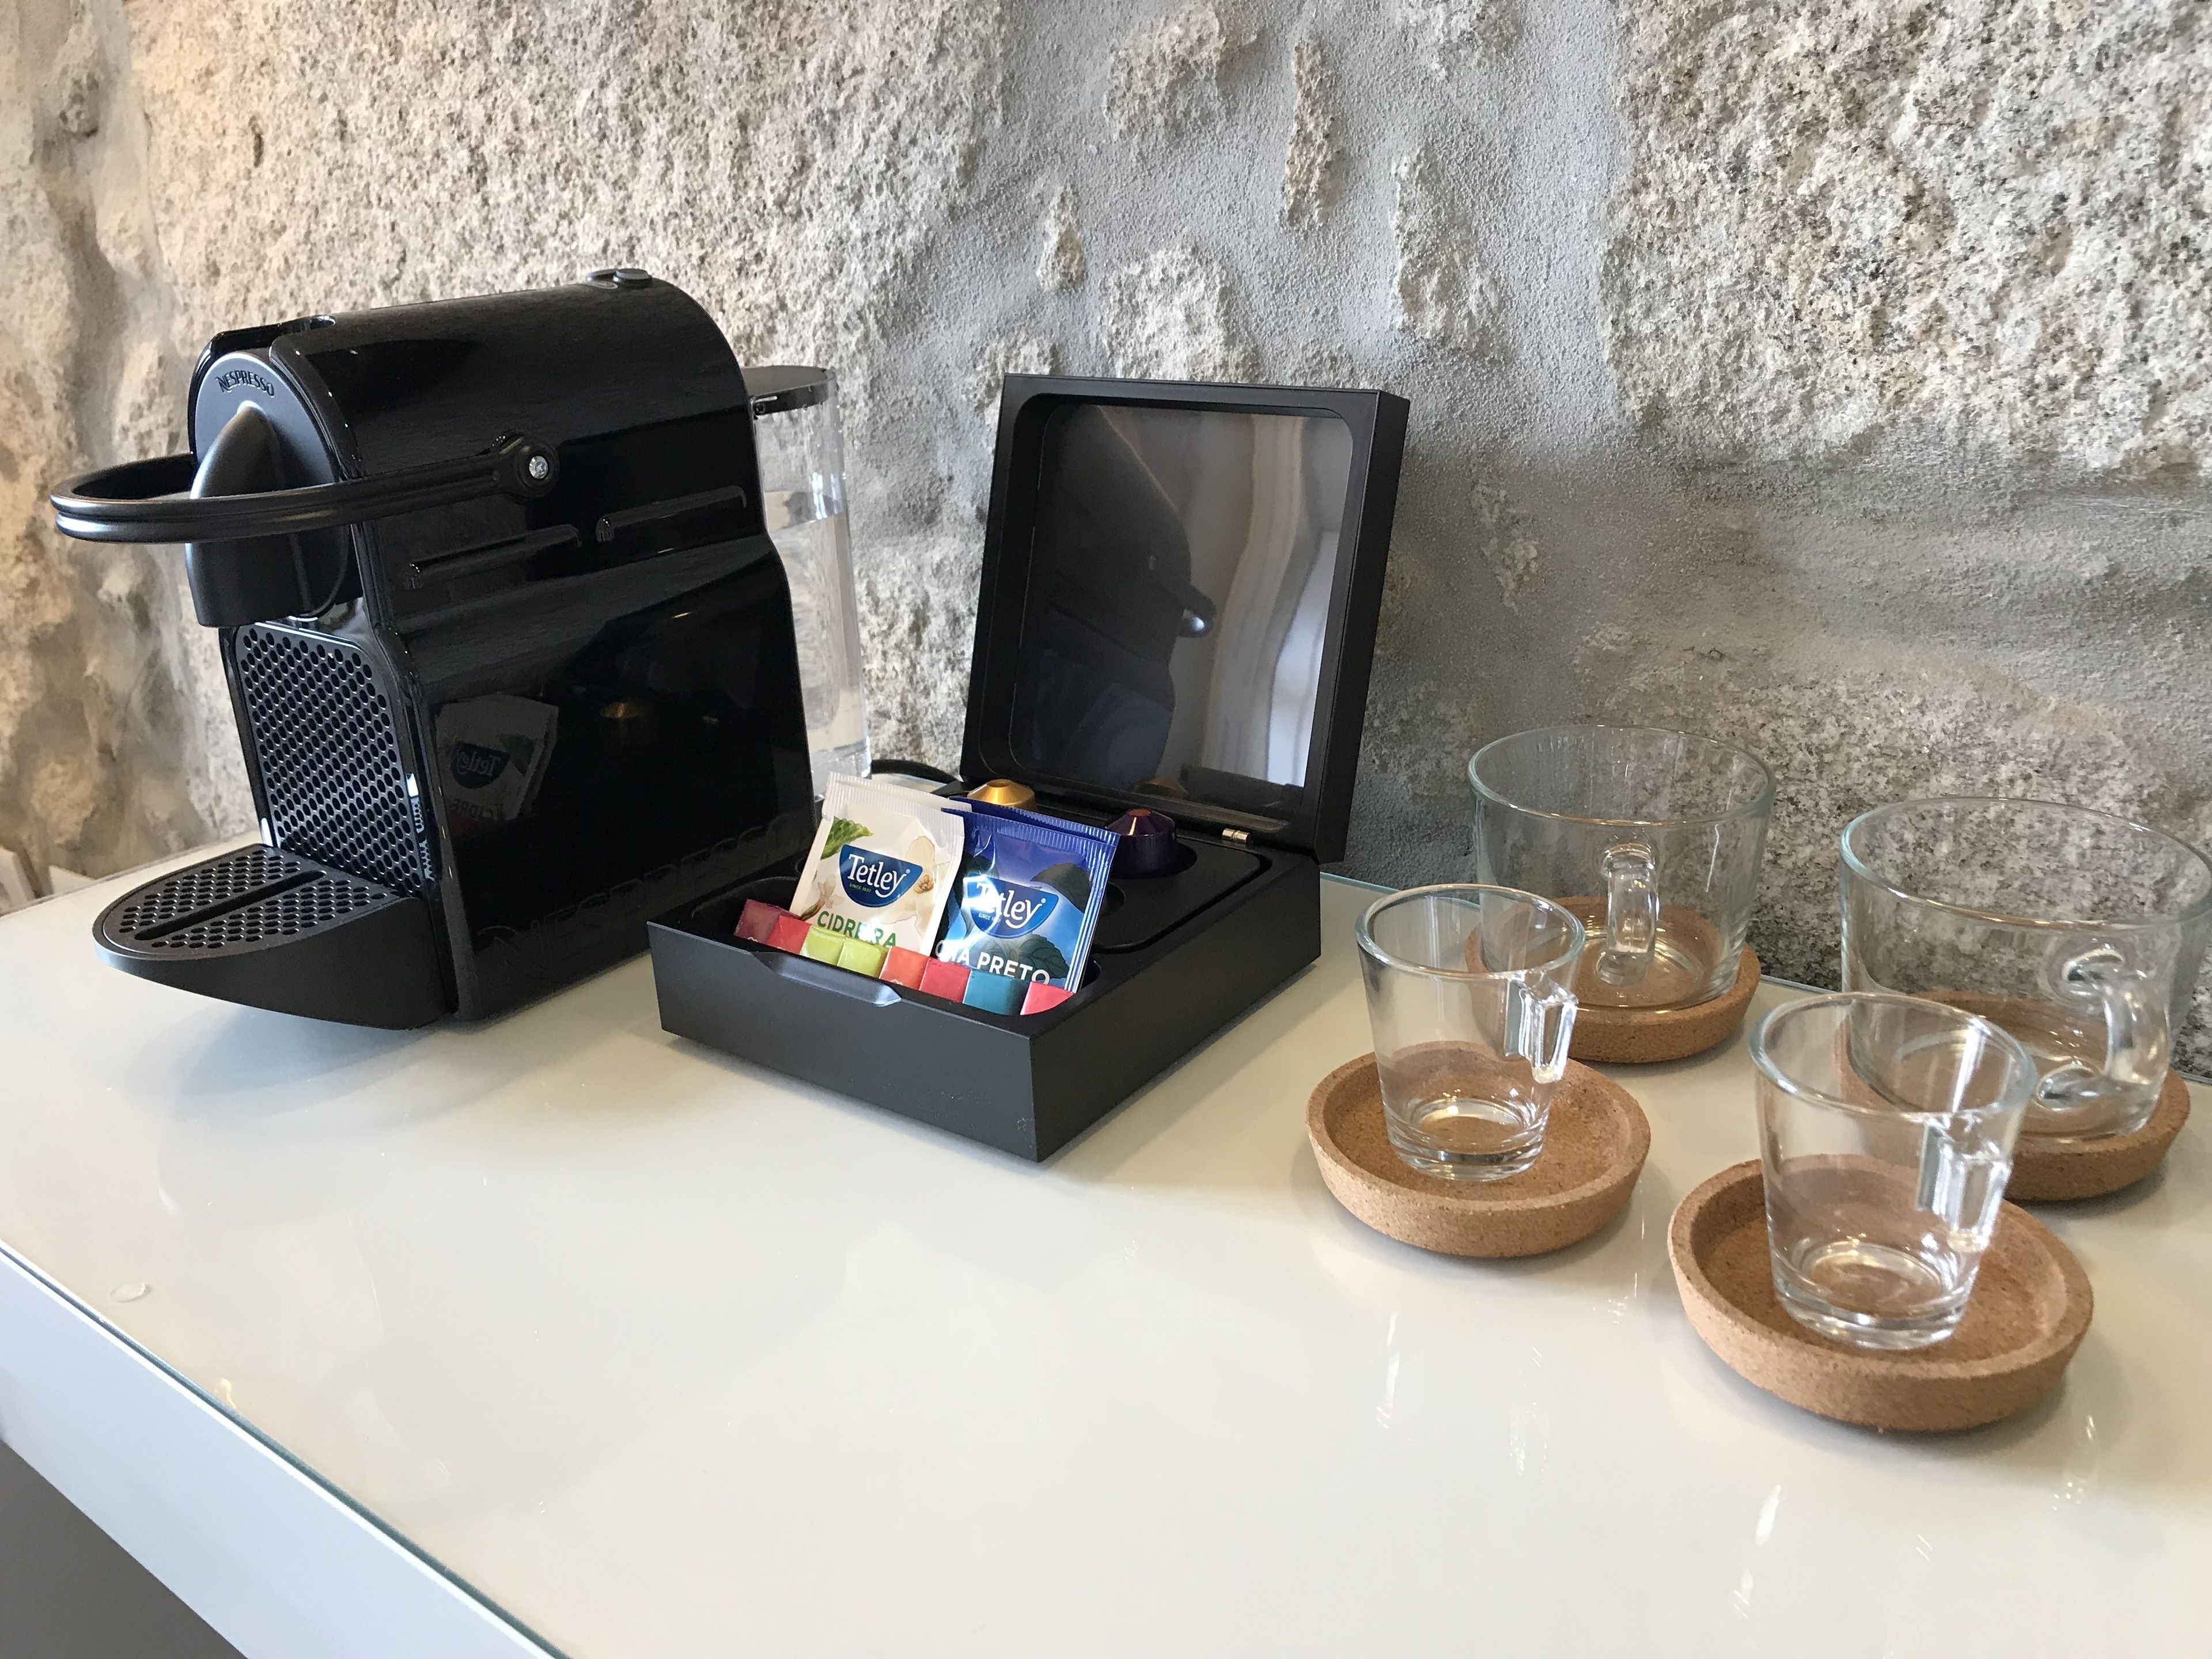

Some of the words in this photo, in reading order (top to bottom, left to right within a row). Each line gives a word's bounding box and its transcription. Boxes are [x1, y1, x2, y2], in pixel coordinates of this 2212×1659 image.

[215, 370, 274, 396] NESPRESSO
[847, 854, 907, 898] Tetley
[977, 952, 1050, 985] PRETO
